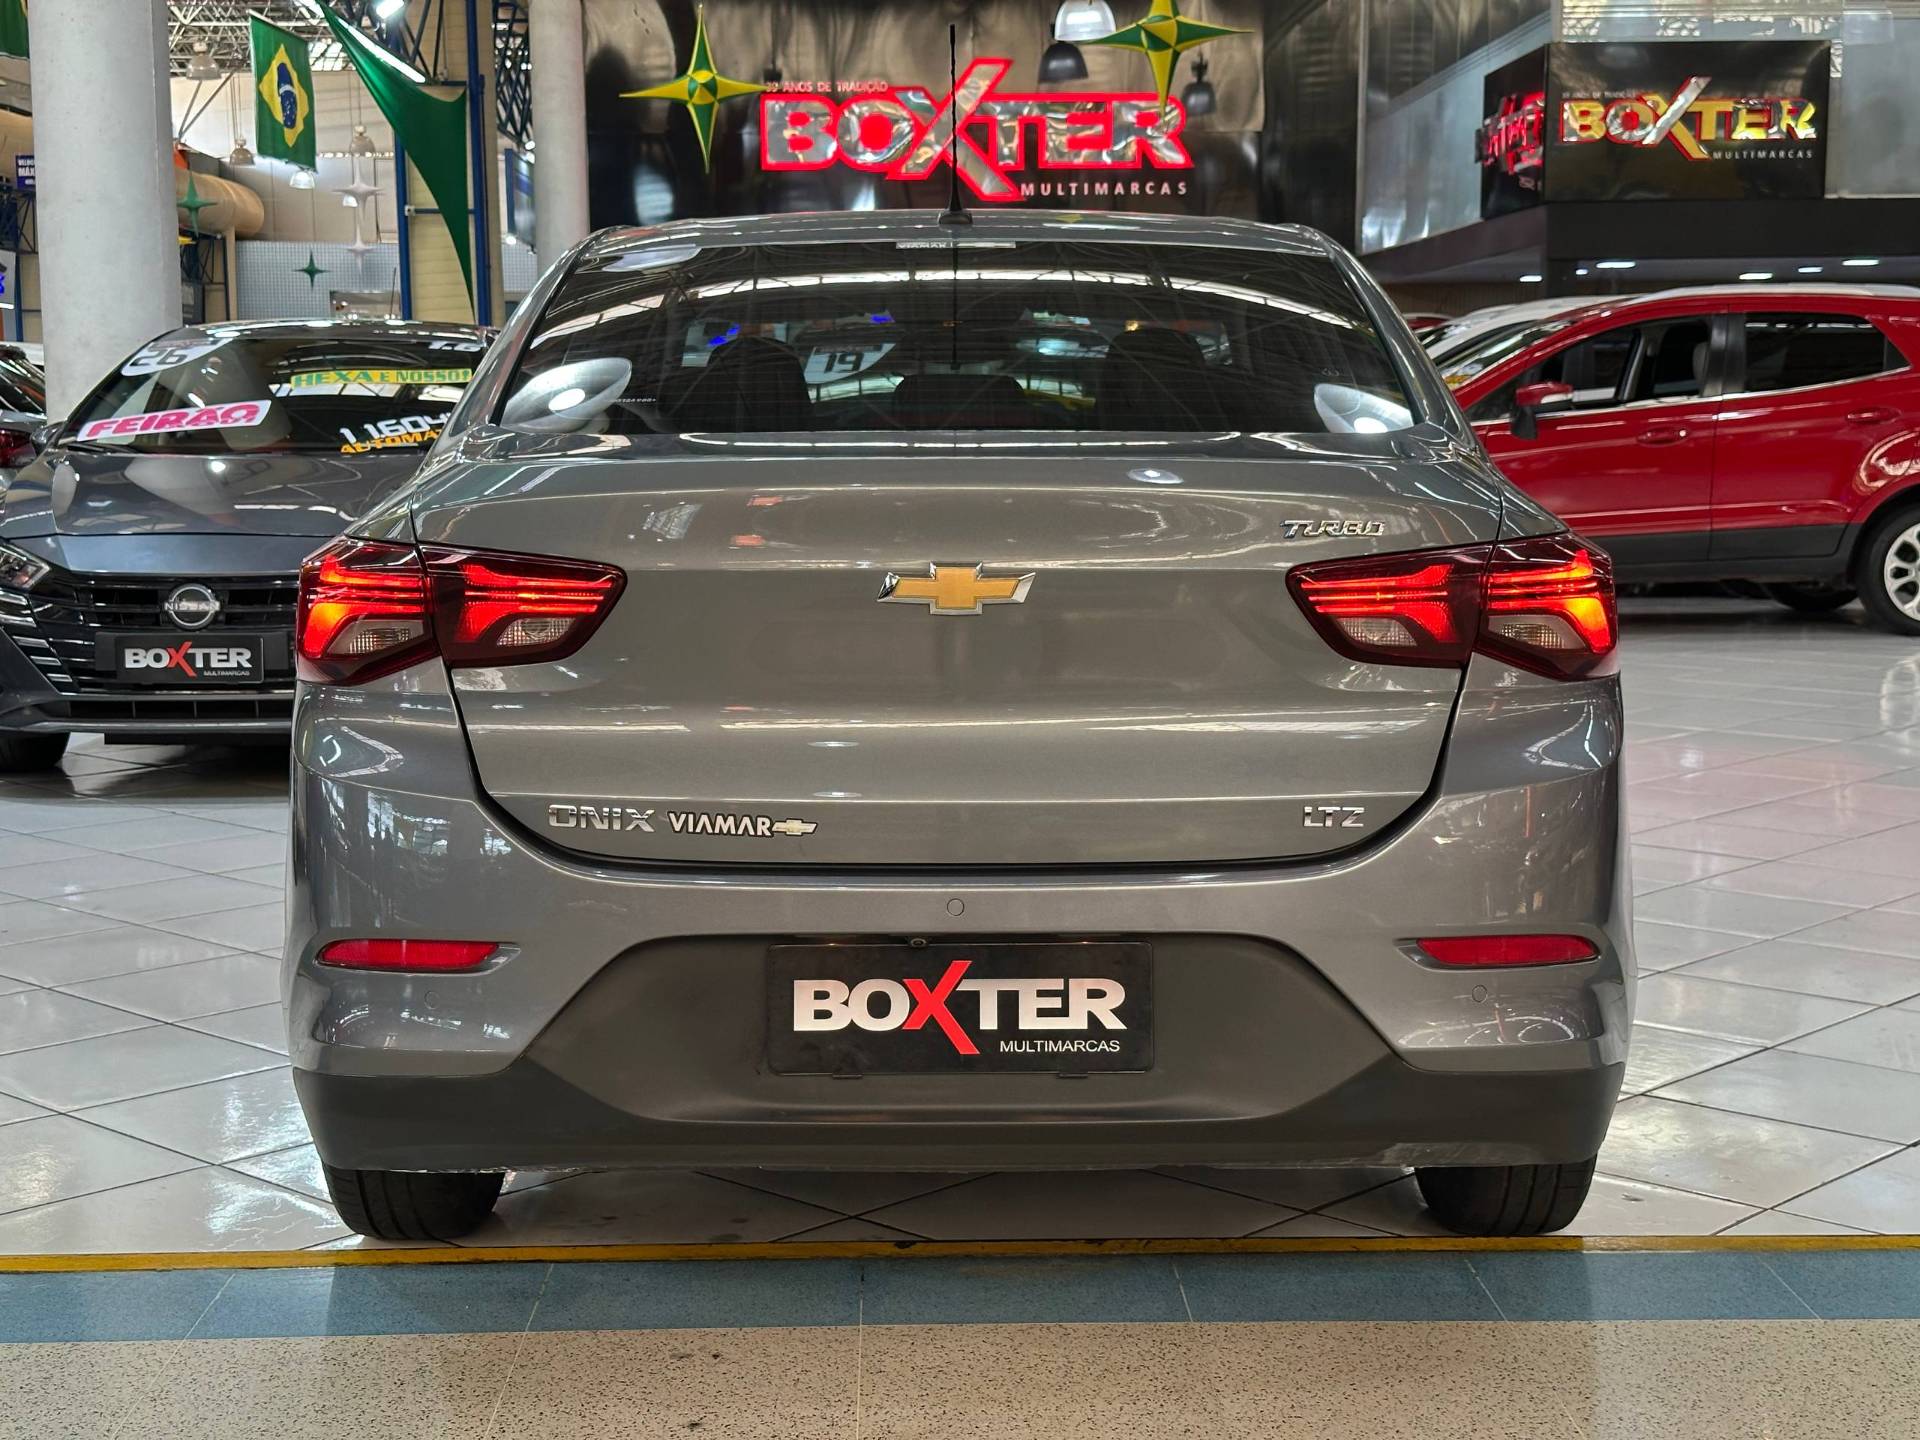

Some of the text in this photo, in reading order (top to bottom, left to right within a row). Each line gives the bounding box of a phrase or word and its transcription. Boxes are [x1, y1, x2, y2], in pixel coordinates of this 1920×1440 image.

[783, 81, 813, 93] ANOS
[817, 81, 832, 92] DE
[1560, 75, 1818, 161] BOXTER
[760, 57, 1195, 201] BOXTER
[1713, 149, 1813, 160] MULTIMARCAS
[1020, 182, 1188, 196] MULTIMARCAS
[293, 370, 376, 388] HEXA
[1281, 519, 1384, 537] TURBO
[164, 600, 221, 612] NISSAN
[124, 640, 253, 678] BOXTER
[548, 804, 773, 837] ONIX VIAMAR
[1303, 806, 1365, 827] LTZ
[793, 960, 1128, 1055] BOXTER
[999, 1039, 1121, 1053] MULTIMARCAS
